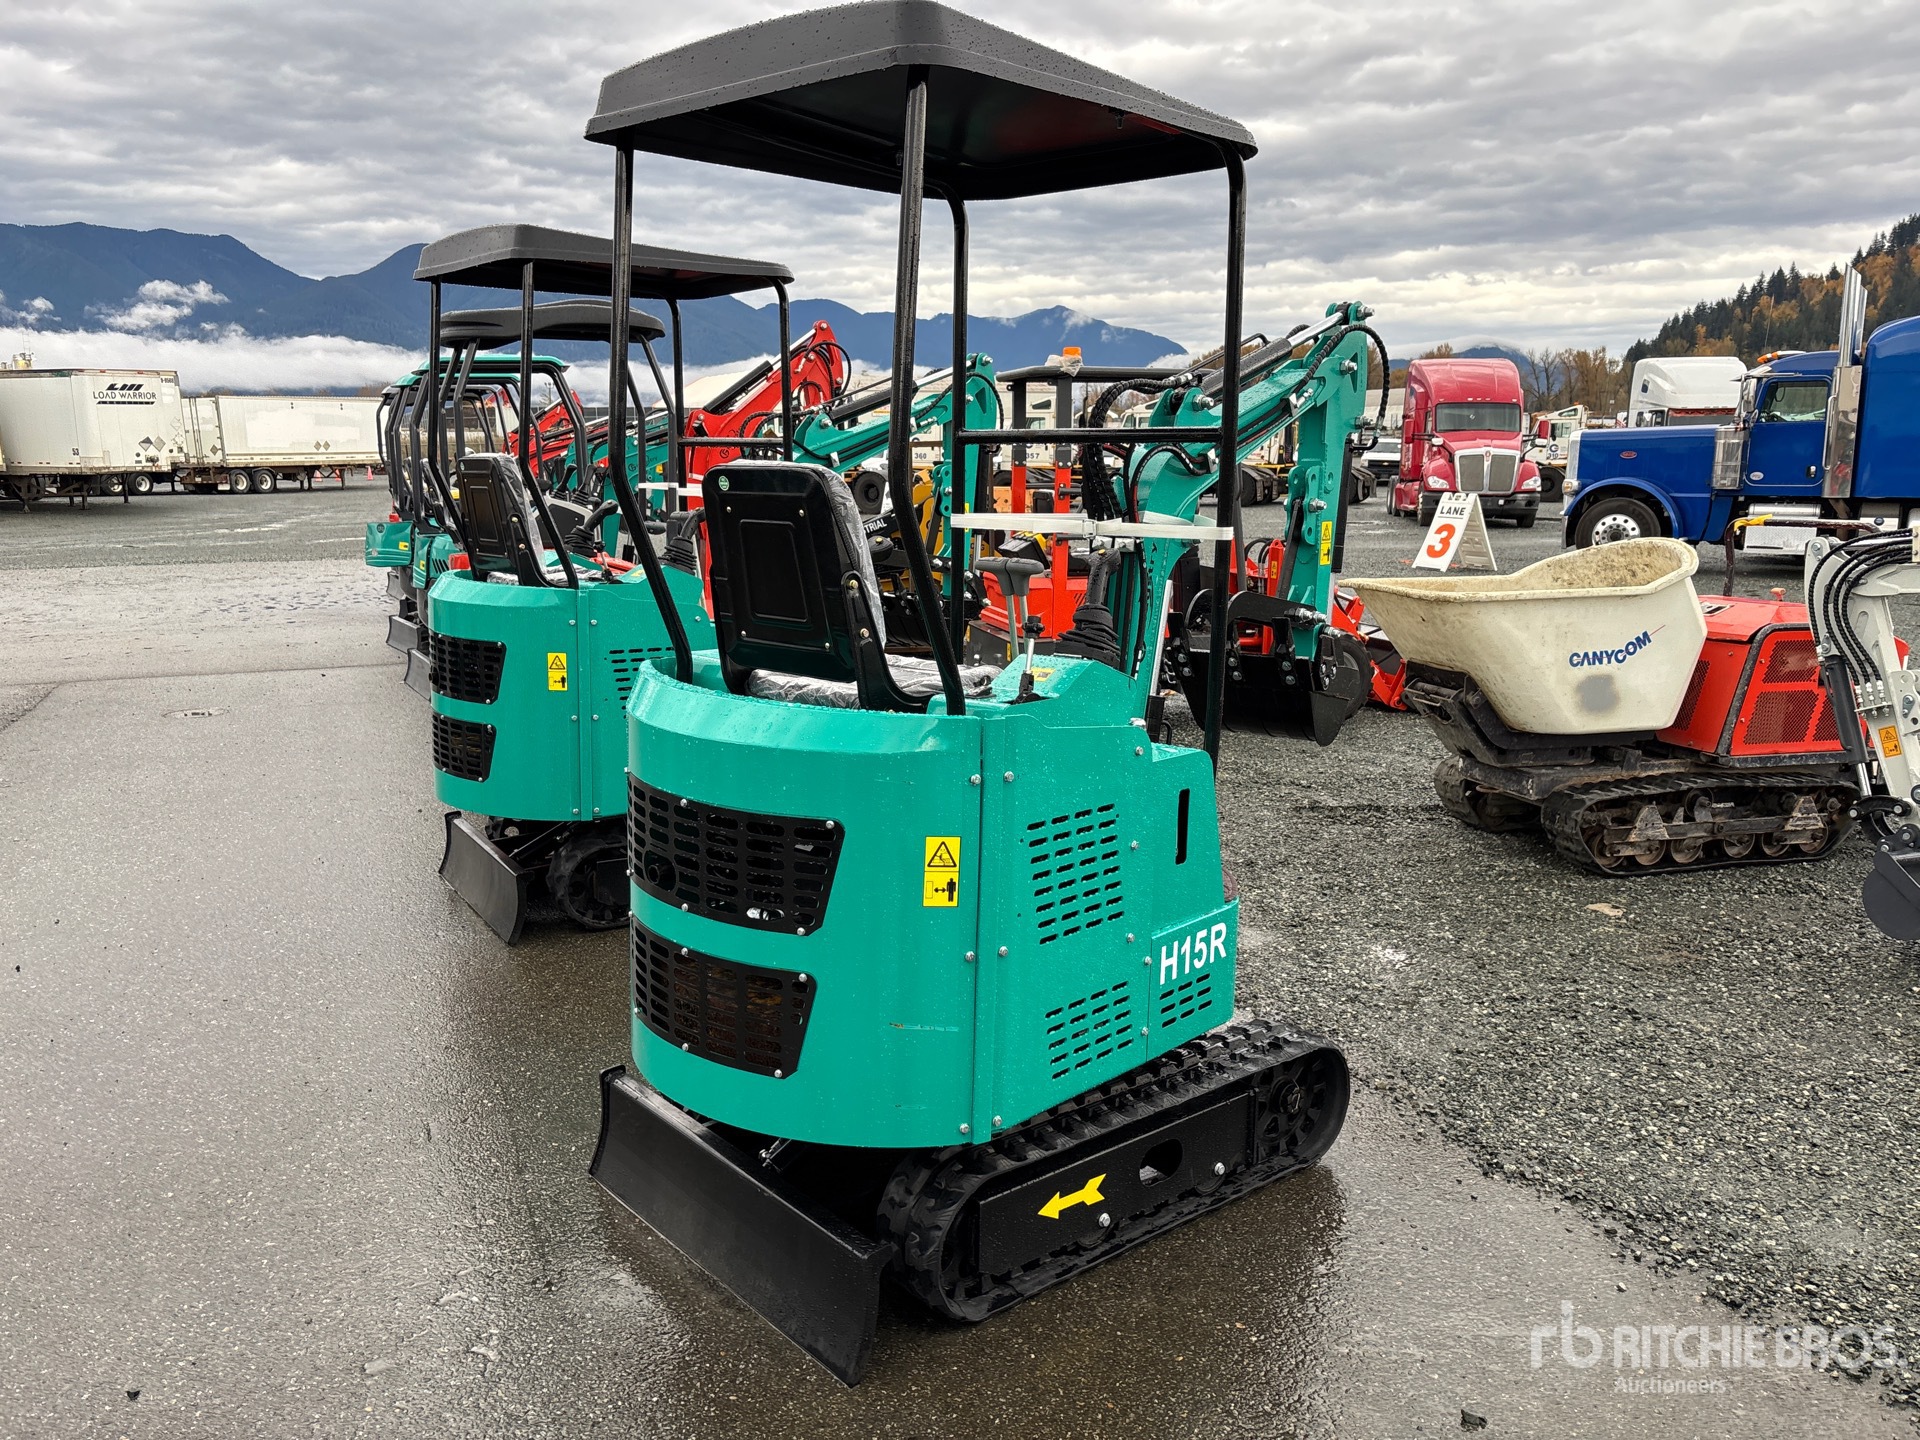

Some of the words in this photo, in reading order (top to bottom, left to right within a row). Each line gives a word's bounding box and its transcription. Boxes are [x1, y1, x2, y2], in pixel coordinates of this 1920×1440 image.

[93, 391, 117, 399] LOAD
[119, 391, 157, 400] WARRIOR
[914, 452, 927, 460] 360
[1440, 506, 1466, 516] LANE
[863, 518, 888, 534] TRIAL
[1426, 523, 1456, 558] 3
[1569, 630, 1652, 668] CANYCOM
[1160, 922, 1227, 985] H15R
